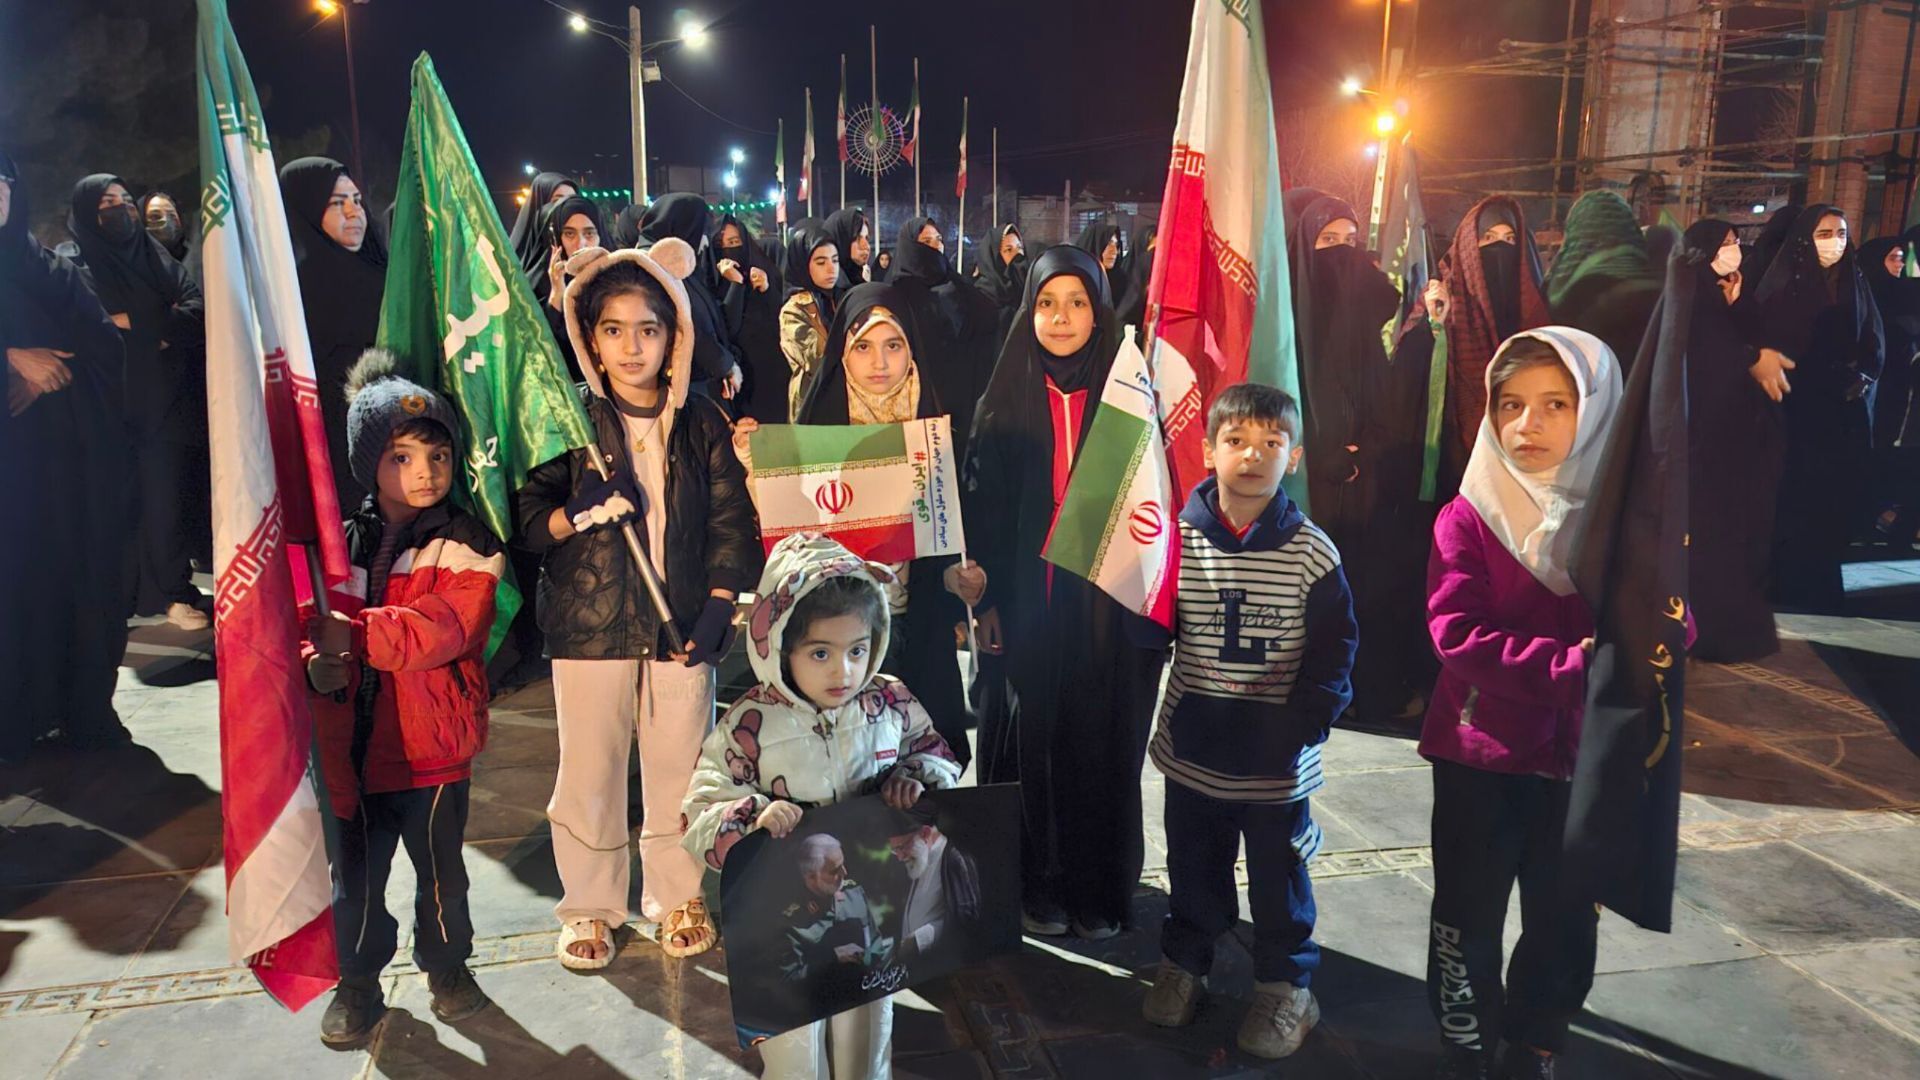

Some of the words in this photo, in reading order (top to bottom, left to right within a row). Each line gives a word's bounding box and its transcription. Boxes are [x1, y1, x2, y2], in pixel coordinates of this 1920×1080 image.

[931, 432, 941, 446] دوم
[932, 447, 942, 465] جهان
[935, 475, 944, 493] حوزه
[936, 494, 946, 511] سلول
[938, 511, 948, 525] های
[1222, 590, 1242, 599] LOS
